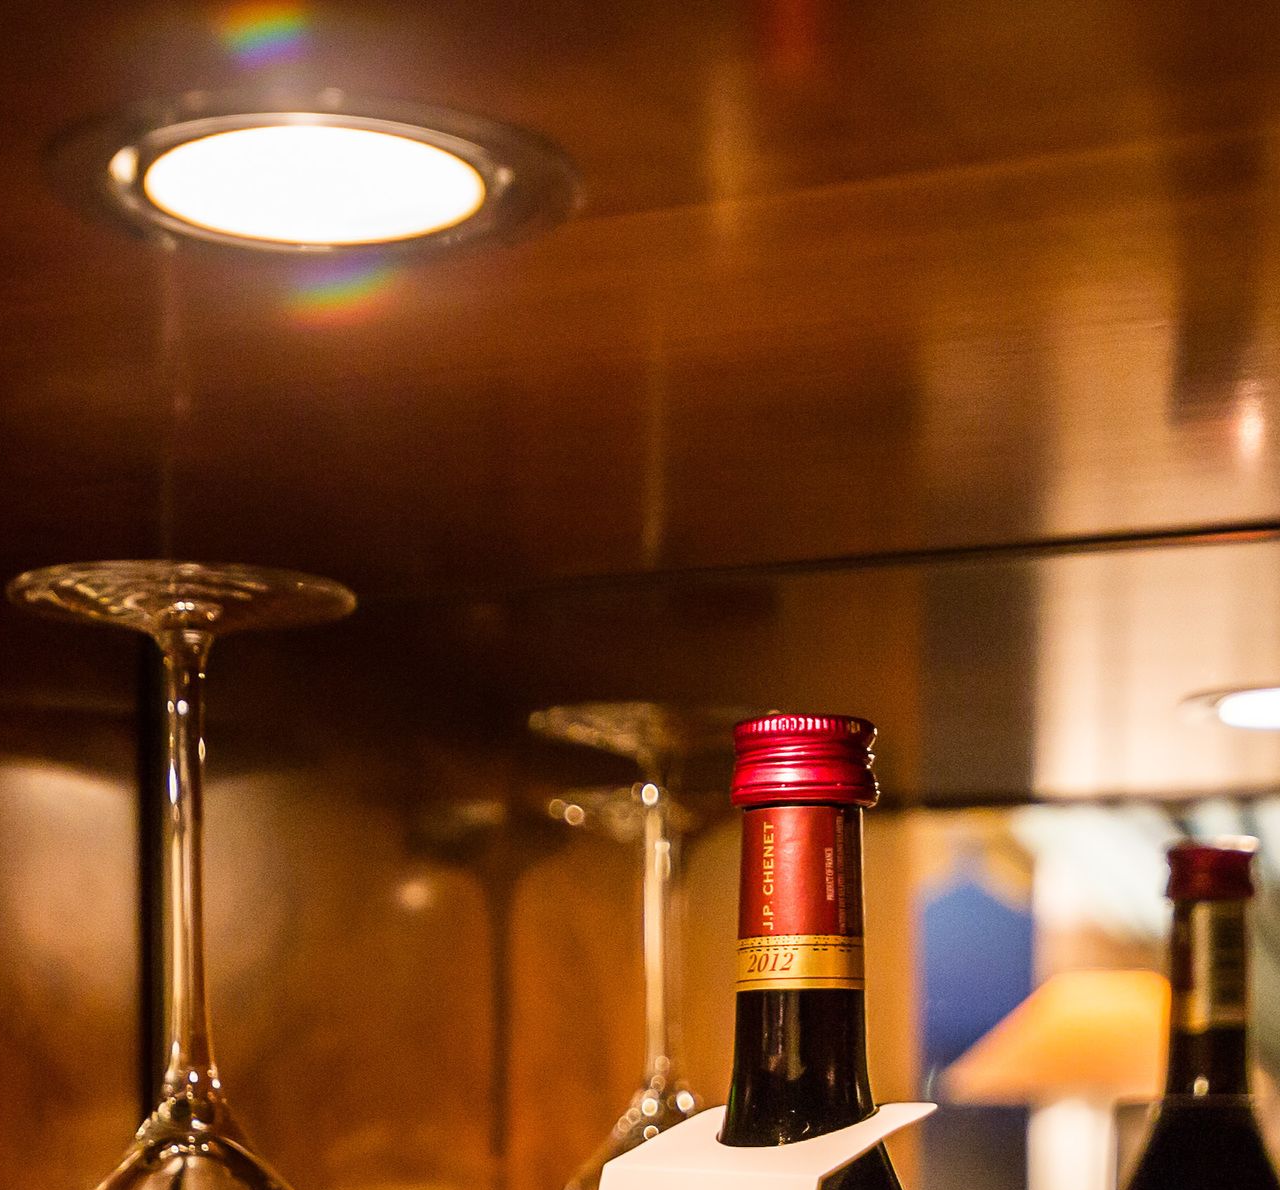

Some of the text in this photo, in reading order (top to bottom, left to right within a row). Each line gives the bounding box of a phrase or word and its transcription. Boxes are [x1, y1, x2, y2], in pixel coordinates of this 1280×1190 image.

[762, 821, 775, 931] J.P. CHENET
[747, 952, 794, 973] 2012
